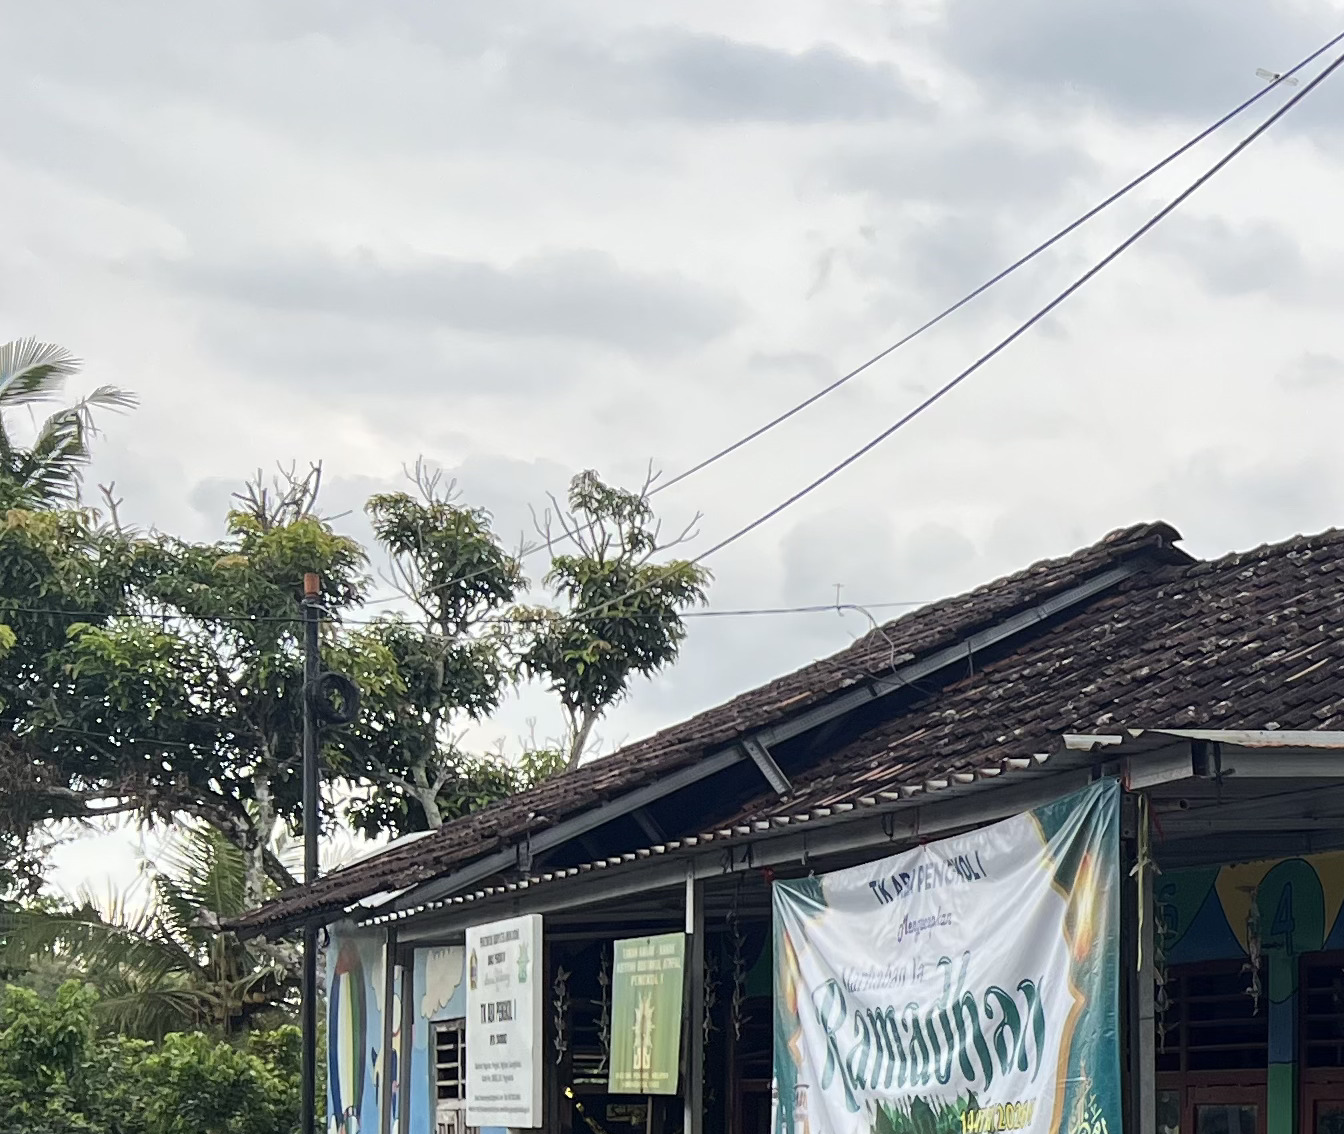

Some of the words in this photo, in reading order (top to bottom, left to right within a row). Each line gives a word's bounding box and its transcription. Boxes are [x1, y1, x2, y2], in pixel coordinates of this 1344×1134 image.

[868, 878, 893, 905] TK
[1271, 881, 1296, 956] 4
[812, 951, 1046, 1113] Ramadhan
